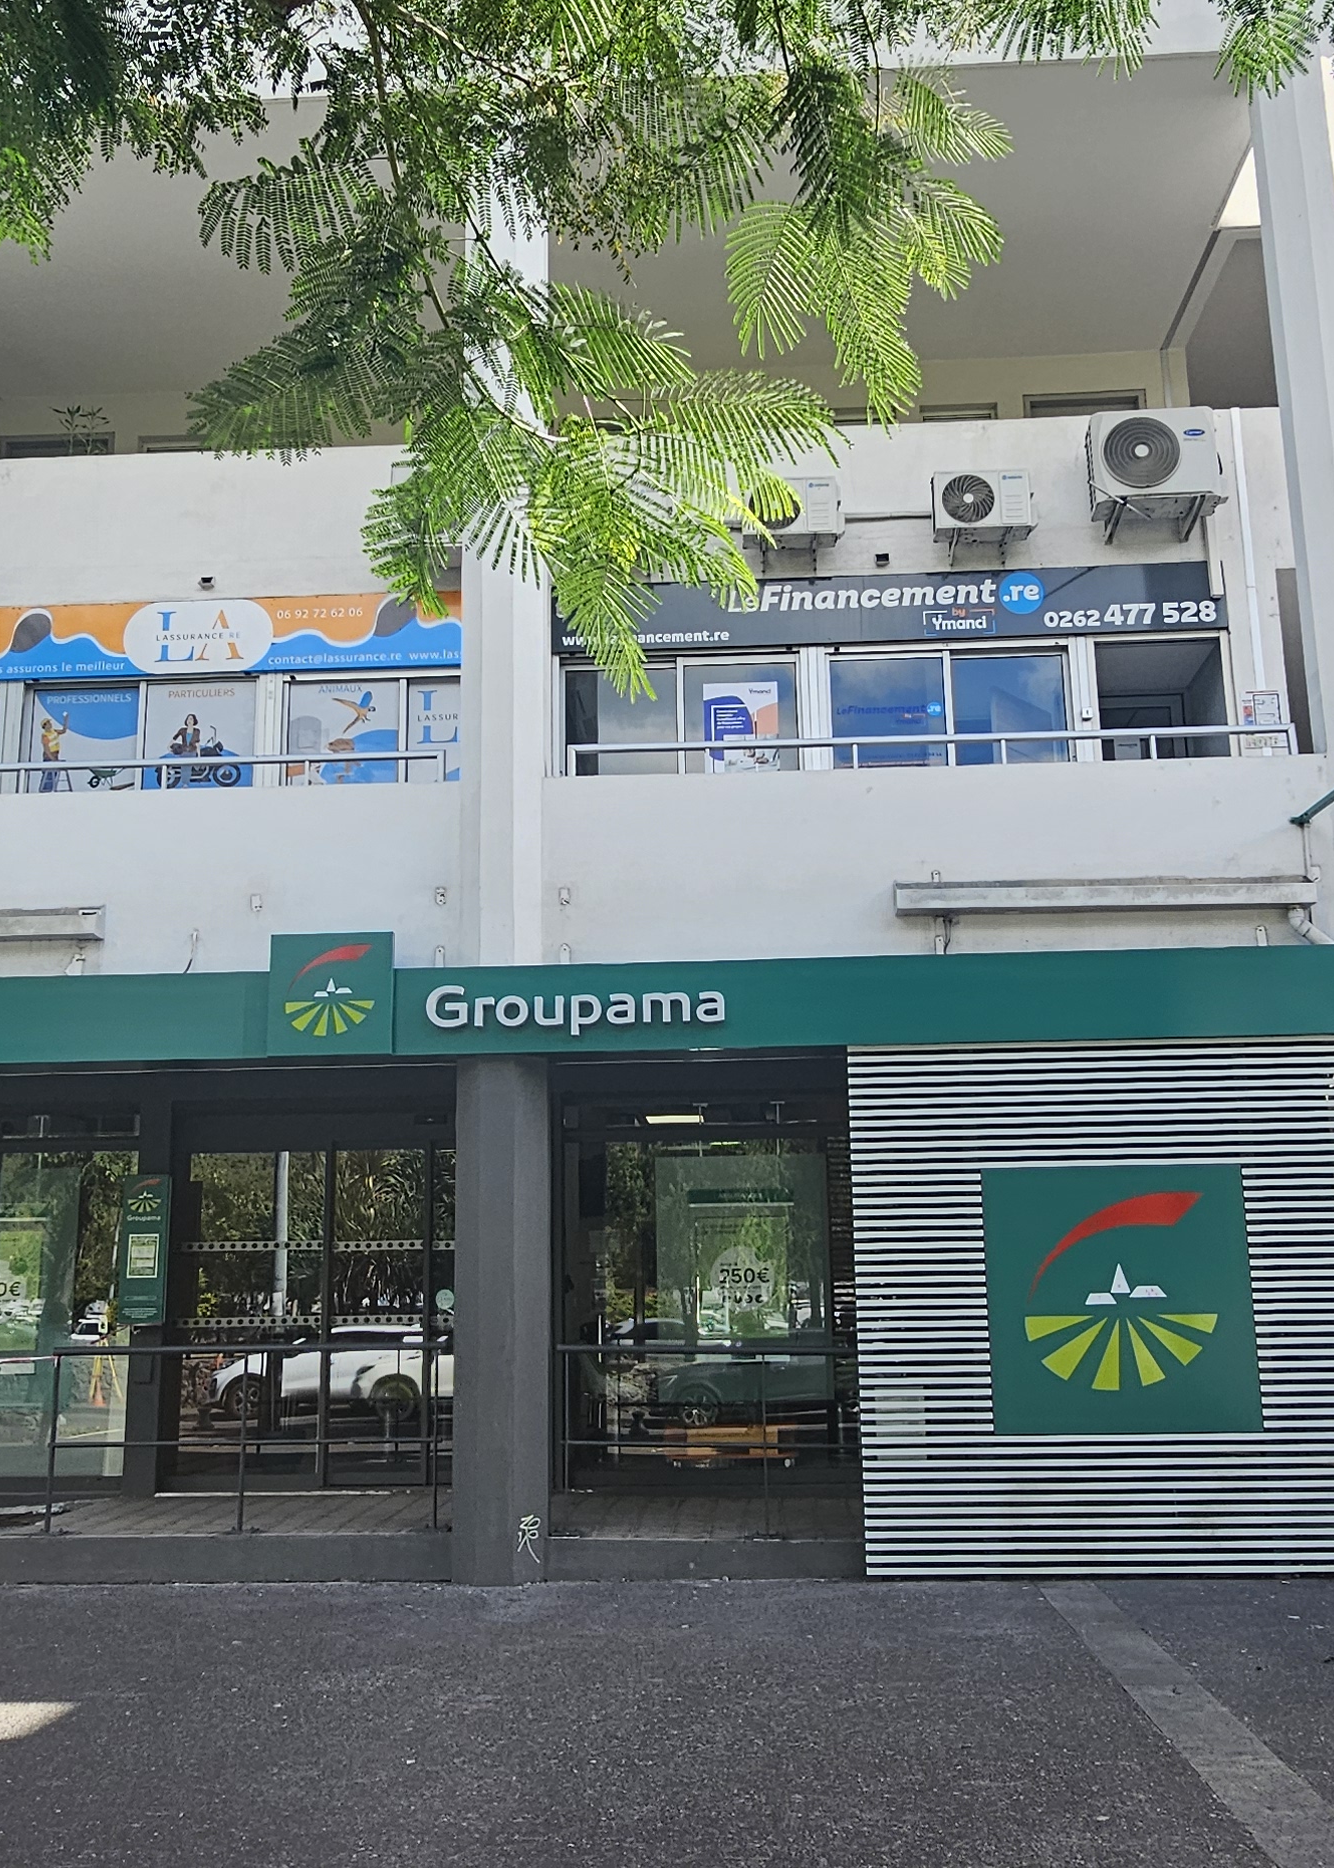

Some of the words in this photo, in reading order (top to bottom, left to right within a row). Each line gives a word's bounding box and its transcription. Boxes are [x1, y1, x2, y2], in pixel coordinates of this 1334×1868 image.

[276, 610, 291, 619] 06
[294, 609, 309, 619] 92
[313, 608, 327, 618] 72
[330, 608, 345, 618] 62
[348, 607, 363, 617] 06
[951, 607, 966, 618] by
[1043, 610, 1101, 628] 0262
[1104, 602, 1156, 626] 477
[1162, 601, 1217, 624] 528
[931, 614, 987, 632] Ymanci
[156, 632, 225, 642] LASSURANCE
[229, 631, 241, 639] RE
[268, 652, 402, 665] contact@lassurance.re
[6, 664, 57, 674] assurons
[61, 661, 73, 673] le
[75, 660, 125, 672] meilleur
[168, 687, 236, 698] PARTICULIERS
[318, 684, 363, 694] ANIMAUX
[46, 693, 132, 705] PROFESSIONNELS
[425, 984, 726, 1036] Groupama
